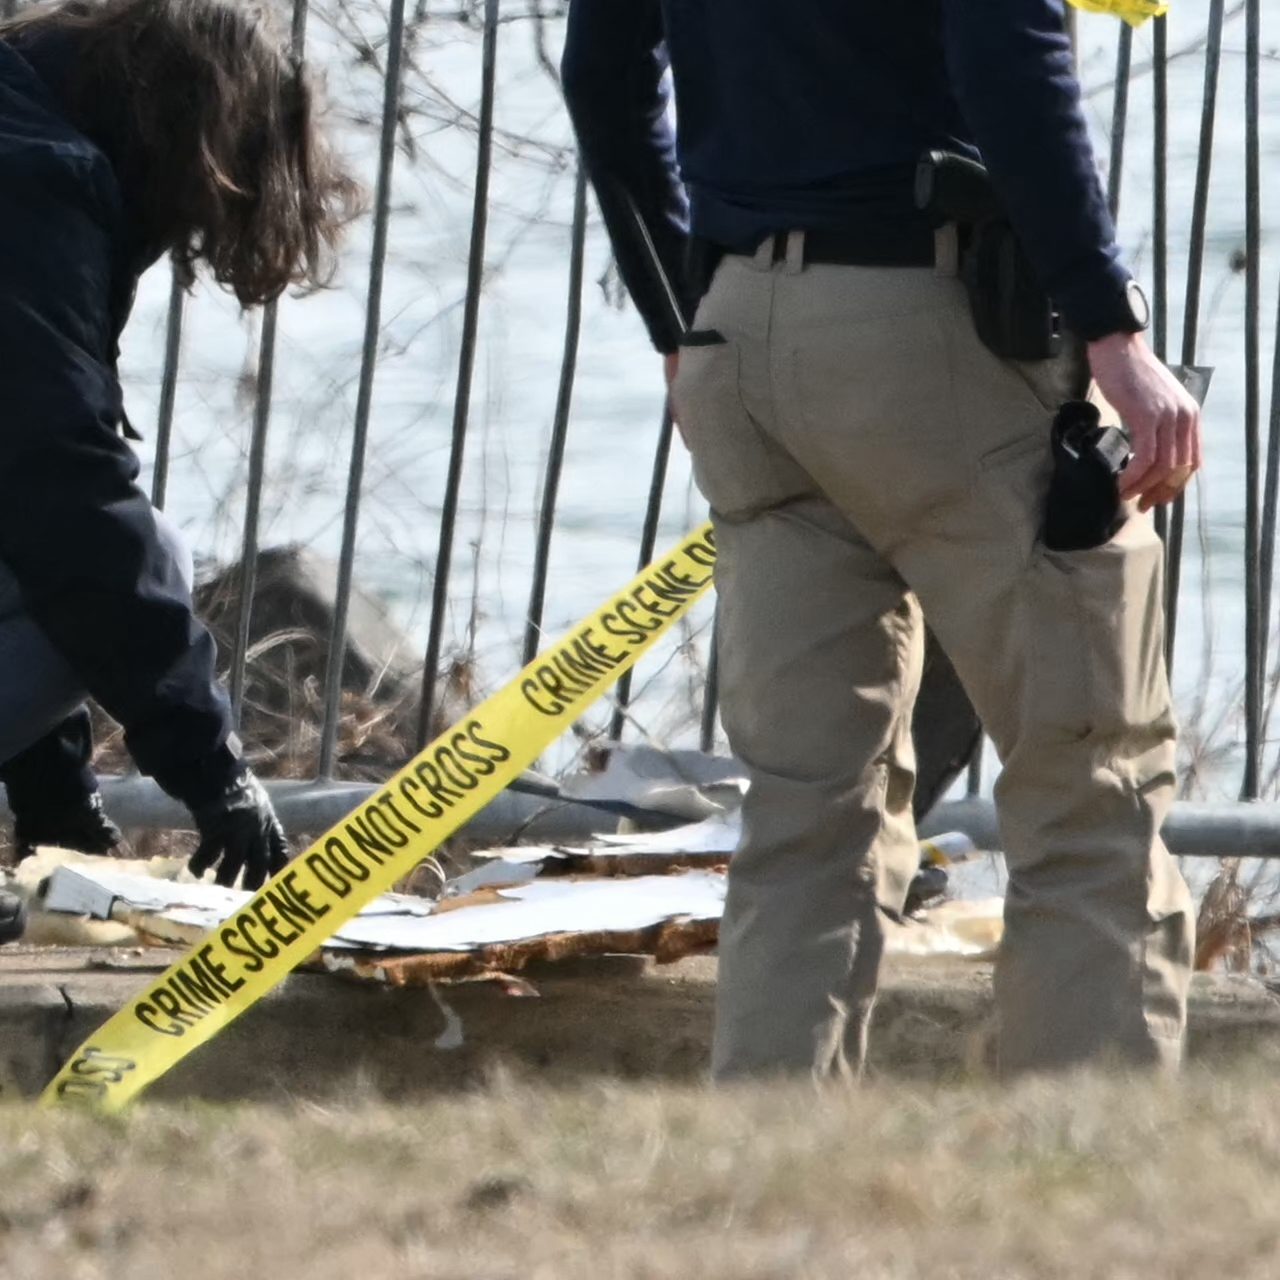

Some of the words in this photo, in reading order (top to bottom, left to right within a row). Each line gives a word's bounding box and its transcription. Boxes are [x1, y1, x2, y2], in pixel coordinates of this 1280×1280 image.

[134, 943, 247, 1037] CRIME
[220, 869, 331, 972] SCENE
[305, 836, 371, 899] DO
[345, 789, 422, 865] NOT
[398, 719, 512, 819] CROSS
[519, 627, 631, 716] CRIME
[599, 560, 713, 645] SCENE
